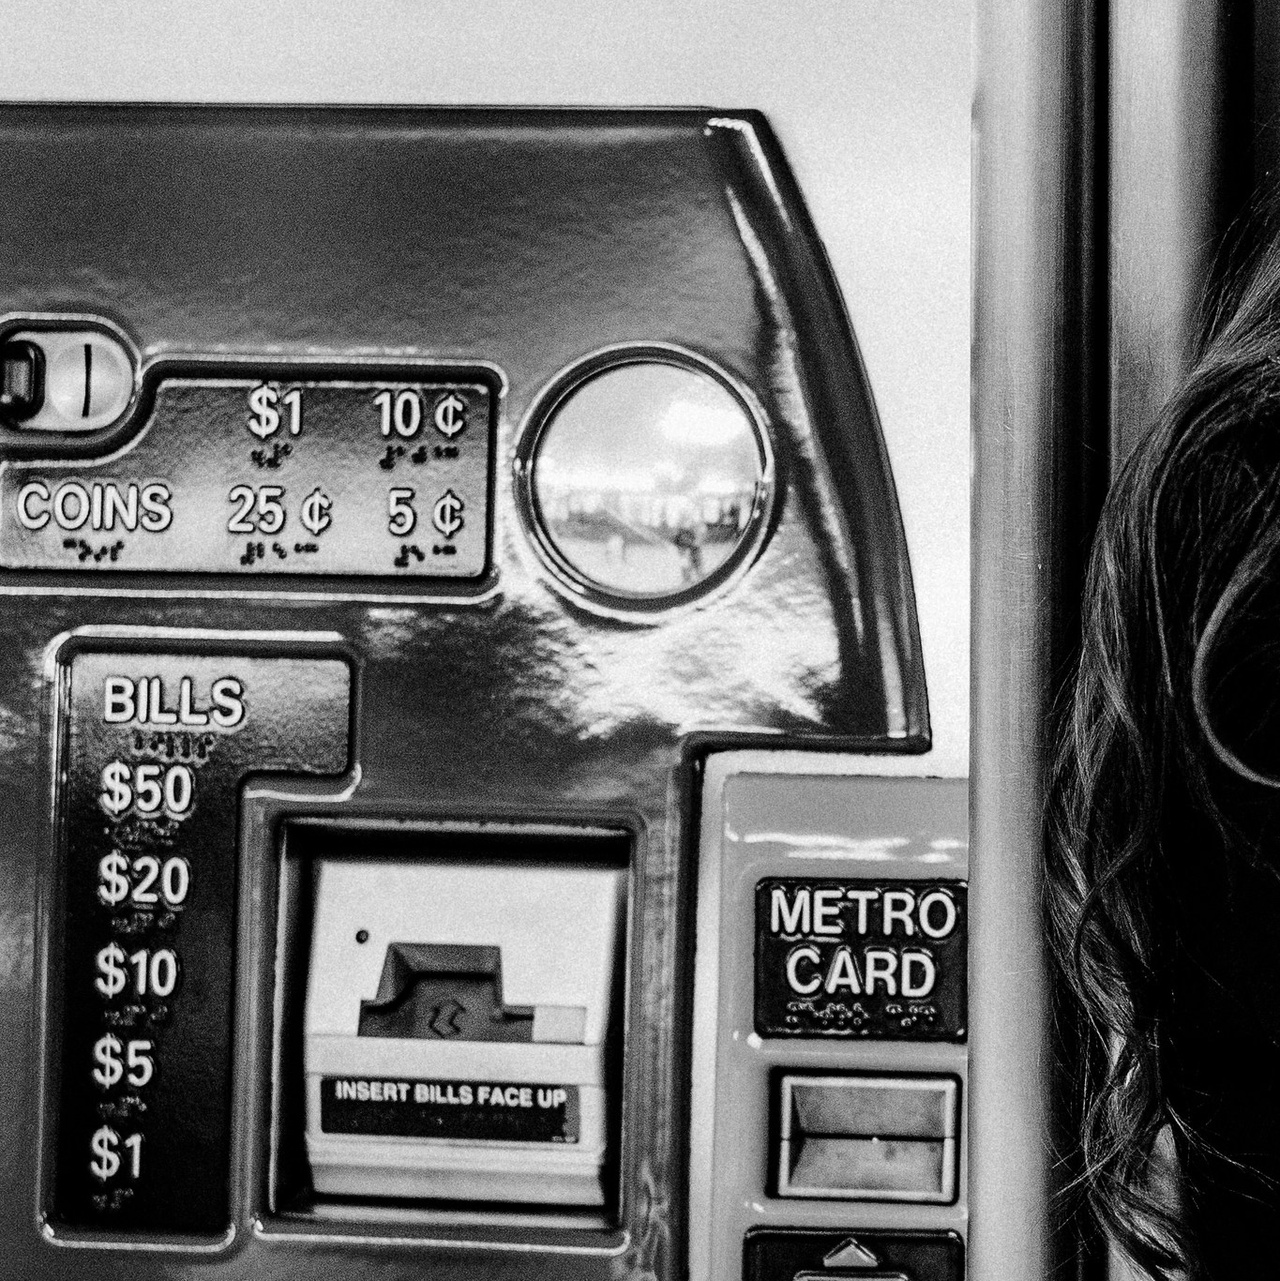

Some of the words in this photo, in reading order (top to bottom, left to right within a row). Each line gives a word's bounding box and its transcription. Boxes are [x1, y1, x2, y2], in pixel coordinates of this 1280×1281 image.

[248, 385, 302, 439] $1
[16, 481, 172, 532] COINS
[103, 677, 245, 727] BILLS
[101, 760, 193, 814] $50
[99, 851, 189, 906] $20
[770, 889, 957, 938] METRO
[96, 943, 177, 999] $10
[786, 948, 936, 999] CARD
[93, 1033, 154, 1088] $5
[335, 1080, 410, 1102] INSERT
[414, 1083, 474, 1105] BILLS
[477, 1086, 533, 1108] FACE
[537, 1089, 567, 1109] UP
[90, 1126, 142, 1180] $1
